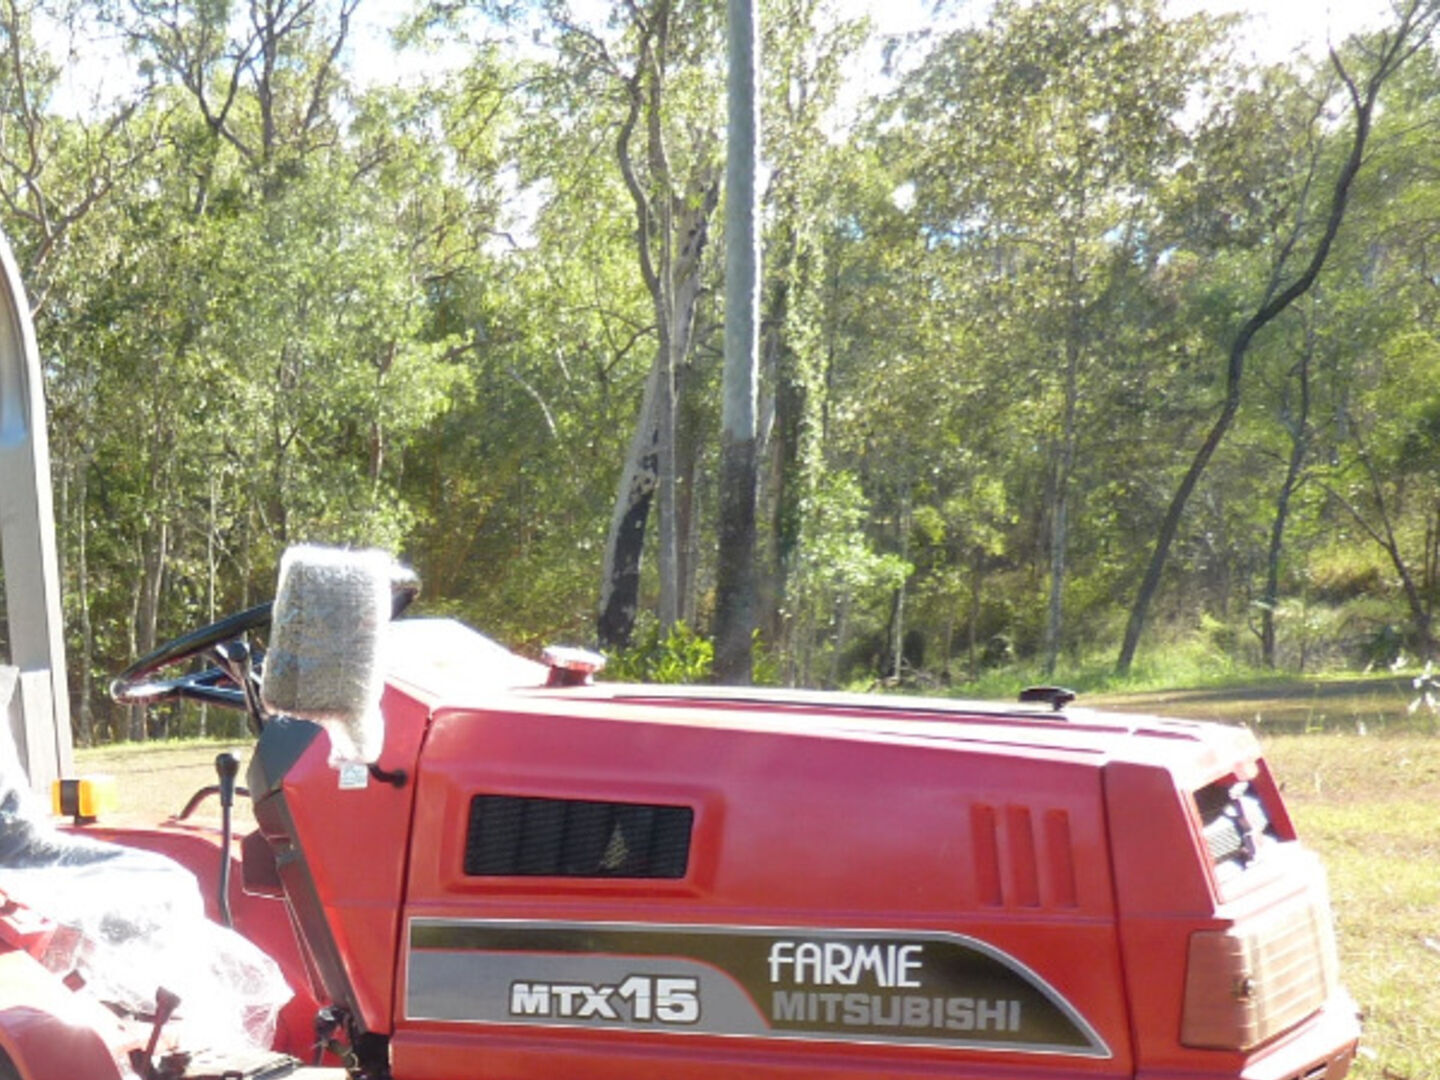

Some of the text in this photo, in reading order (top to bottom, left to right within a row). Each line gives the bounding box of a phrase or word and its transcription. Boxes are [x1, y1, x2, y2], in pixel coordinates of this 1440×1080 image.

[767, 942, 923, 988] FARMIE
[510, 974, 701, 1024] MTX15
[772, 990, 1021, 1032] MITSUBISHI
